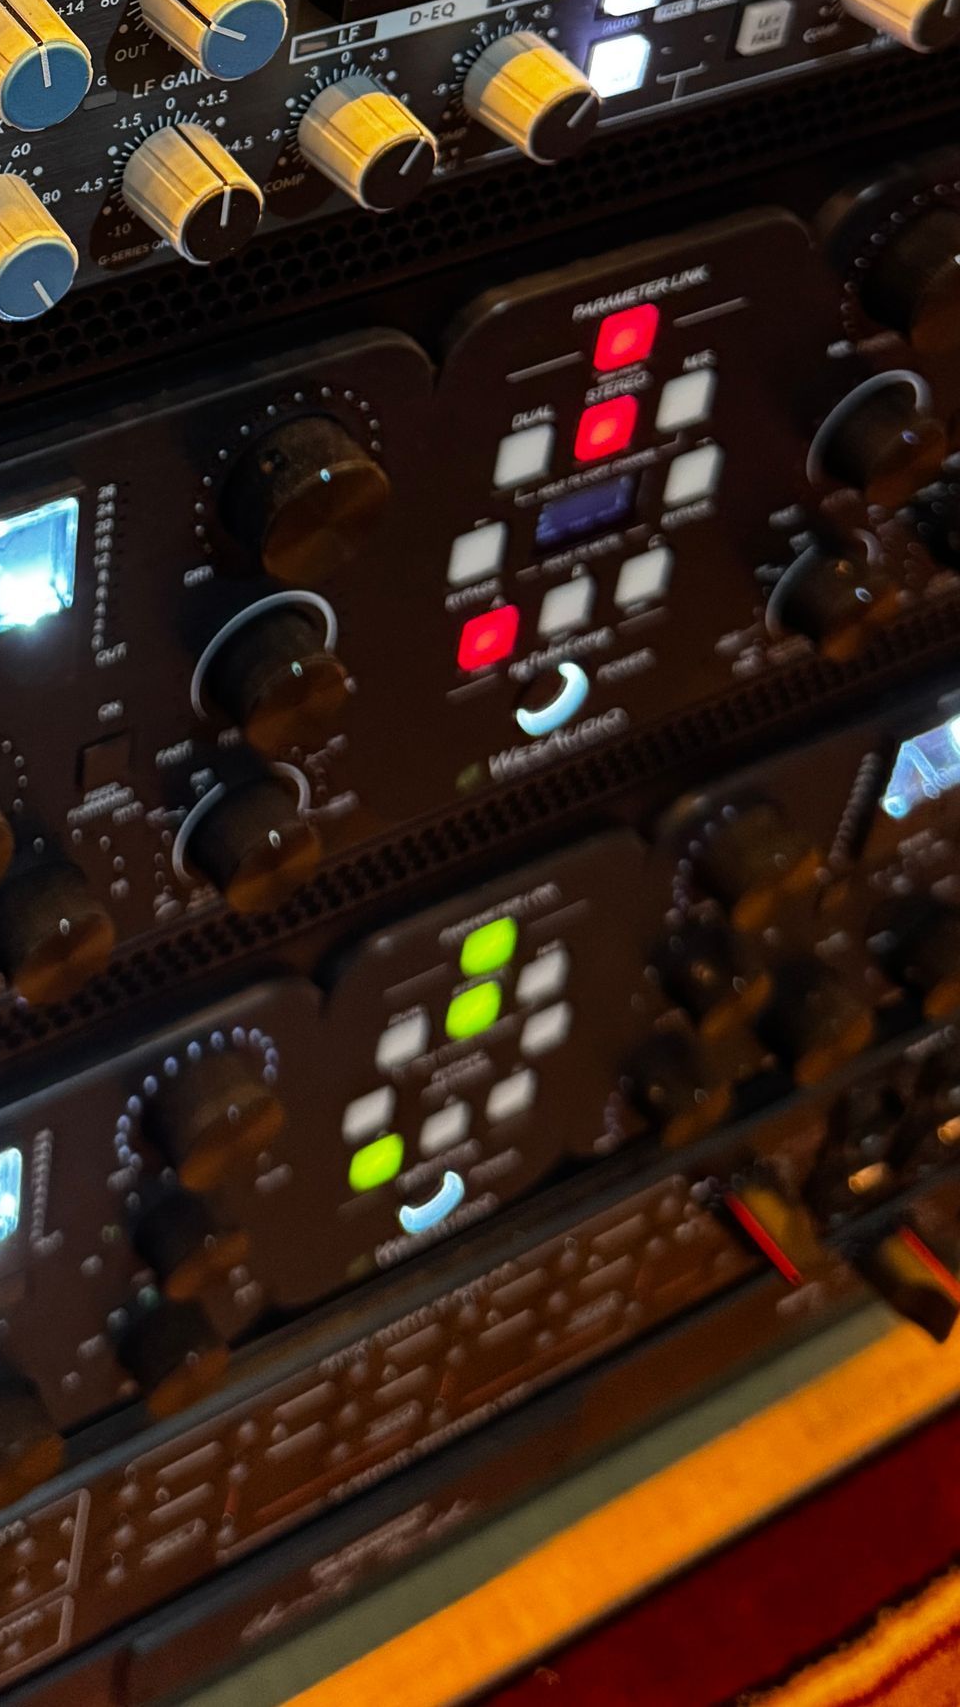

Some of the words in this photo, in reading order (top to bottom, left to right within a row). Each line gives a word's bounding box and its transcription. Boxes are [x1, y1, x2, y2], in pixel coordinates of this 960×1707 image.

[409, 2, 456, 26] D-EQ
[338, 26, 361, 45] LF
[572, 277, 668, 321] PARAMETER
[669, 265, 711, 292] LINK
[586, 371, 650, 403] STEREO
[511, 404, 557, 431] DUAL
